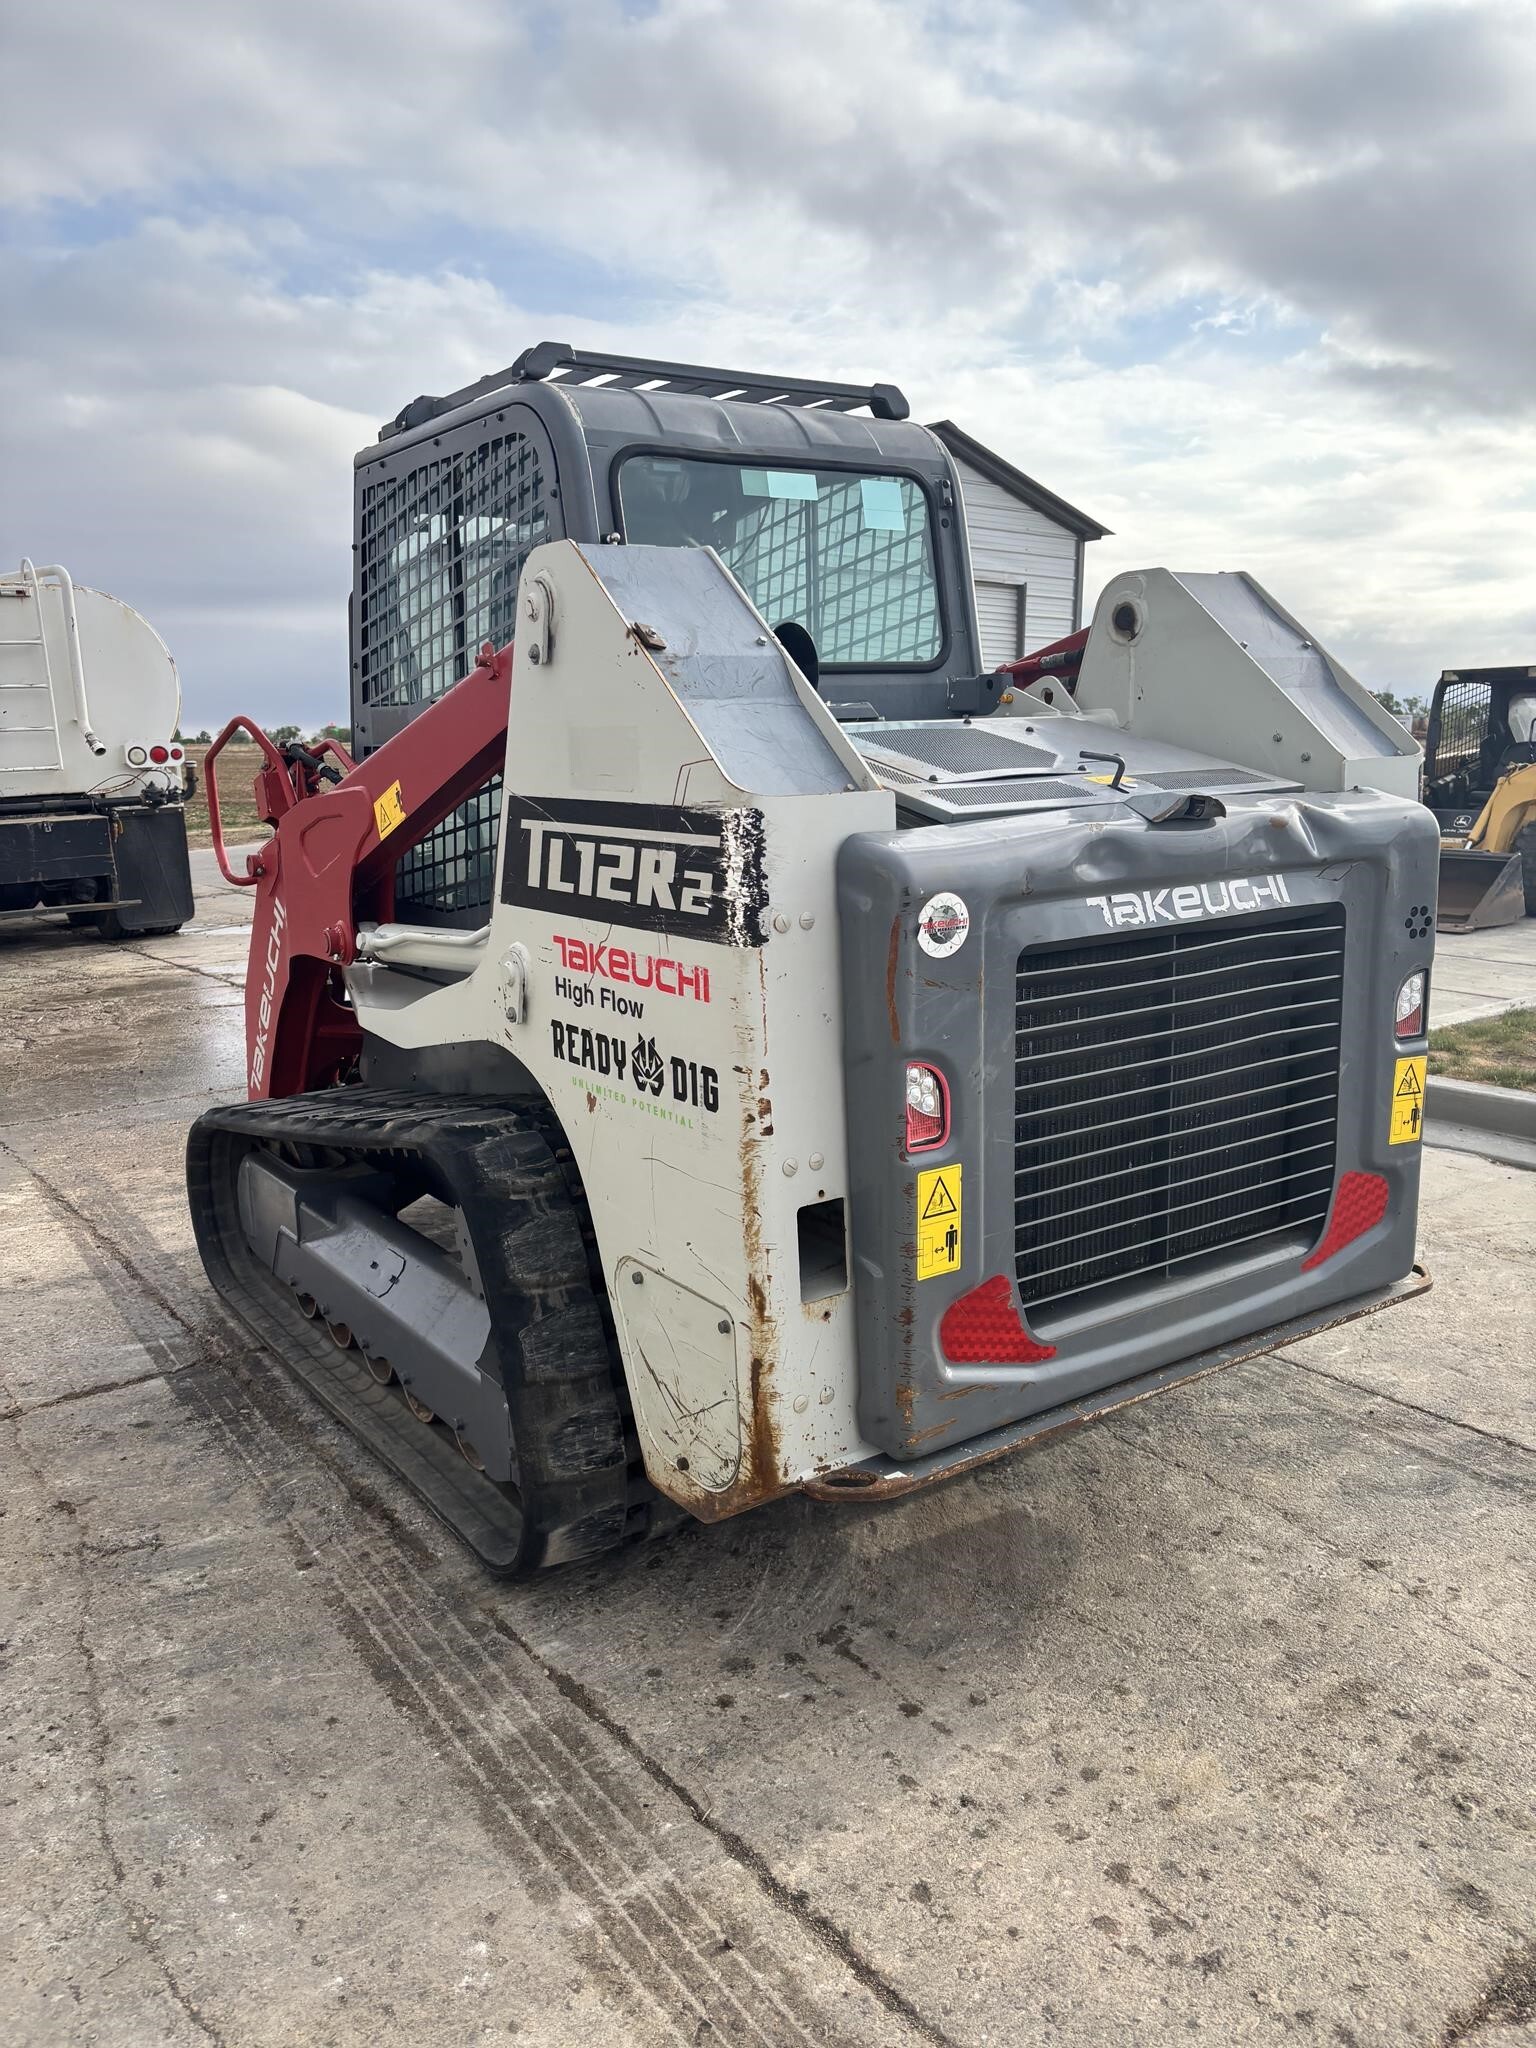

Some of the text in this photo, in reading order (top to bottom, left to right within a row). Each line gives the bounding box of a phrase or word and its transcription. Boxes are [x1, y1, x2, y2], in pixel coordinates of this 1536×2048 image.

[520, 818, 721, 916] TL12R2
[922, 917, 967, 929] AKEUCHI
[1086, 874, 1290, 928] TAKEUCHI
[250, 897, 287, 1091] TAKEUCHI
[553, 935, 711, 1003] TAKEUCHI
[555, 976, 644, 1019] High Flow
[551, 1019, 719, 1113] READY DIG
[571, 1076, 694, 1129] UNLIMITED POTENTIAL
